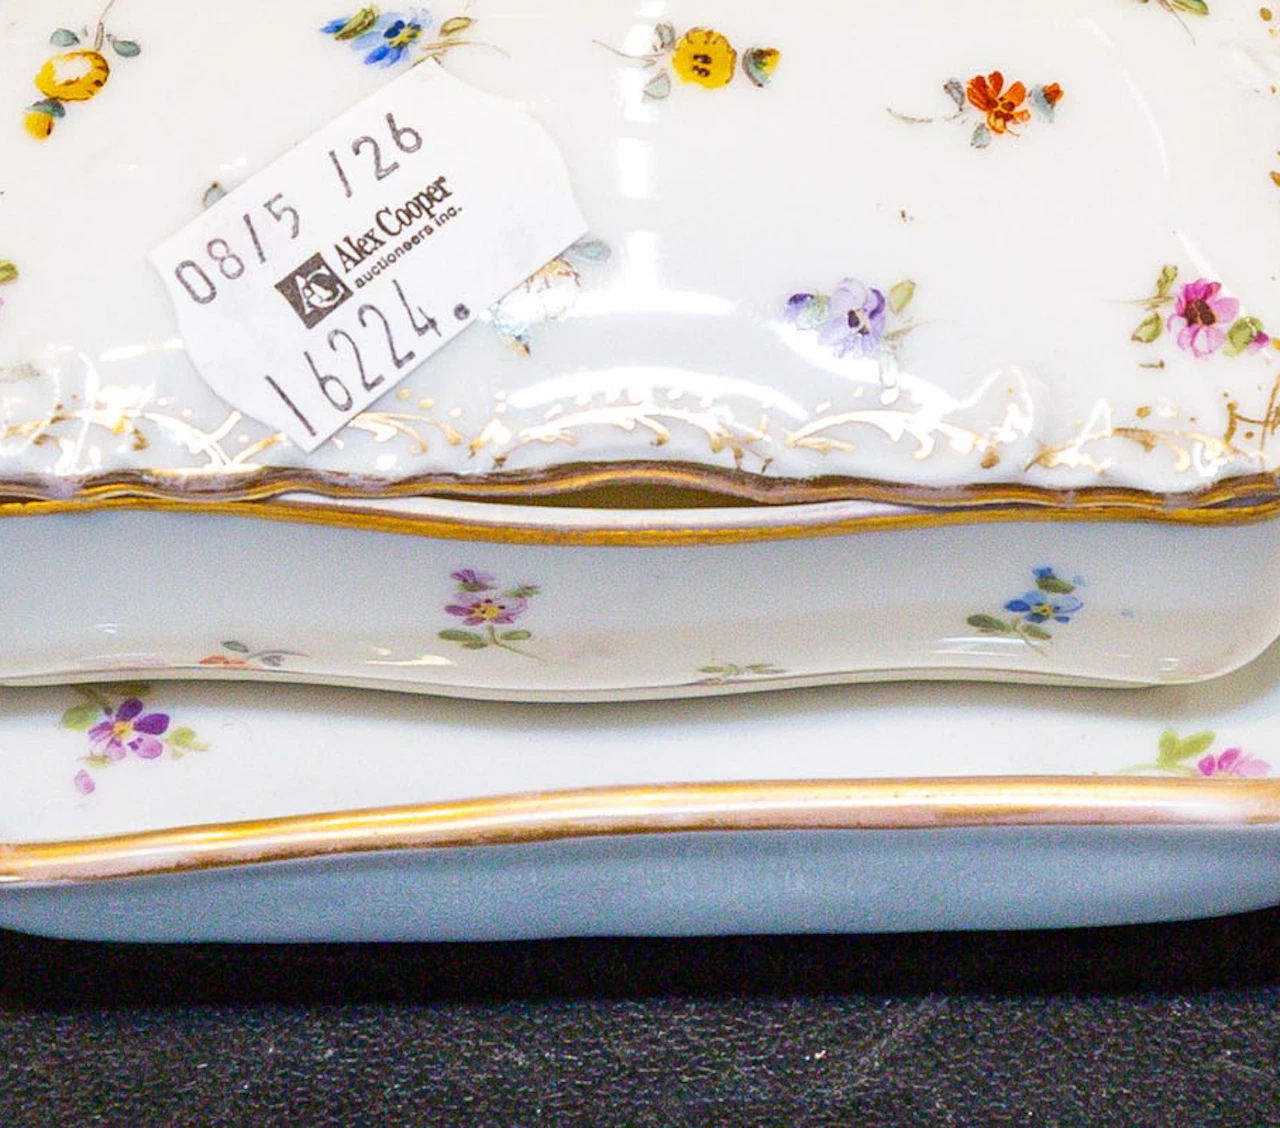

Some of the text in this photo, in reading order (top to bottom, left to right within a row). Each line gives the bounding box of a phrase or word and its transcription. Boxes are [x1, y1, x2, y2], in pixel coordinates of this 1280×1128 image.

[332, 232, 384, 273] Alex
[375, 176, 454, 238] Cooper
[353, 206, 463, 289] auctioneers inc.
